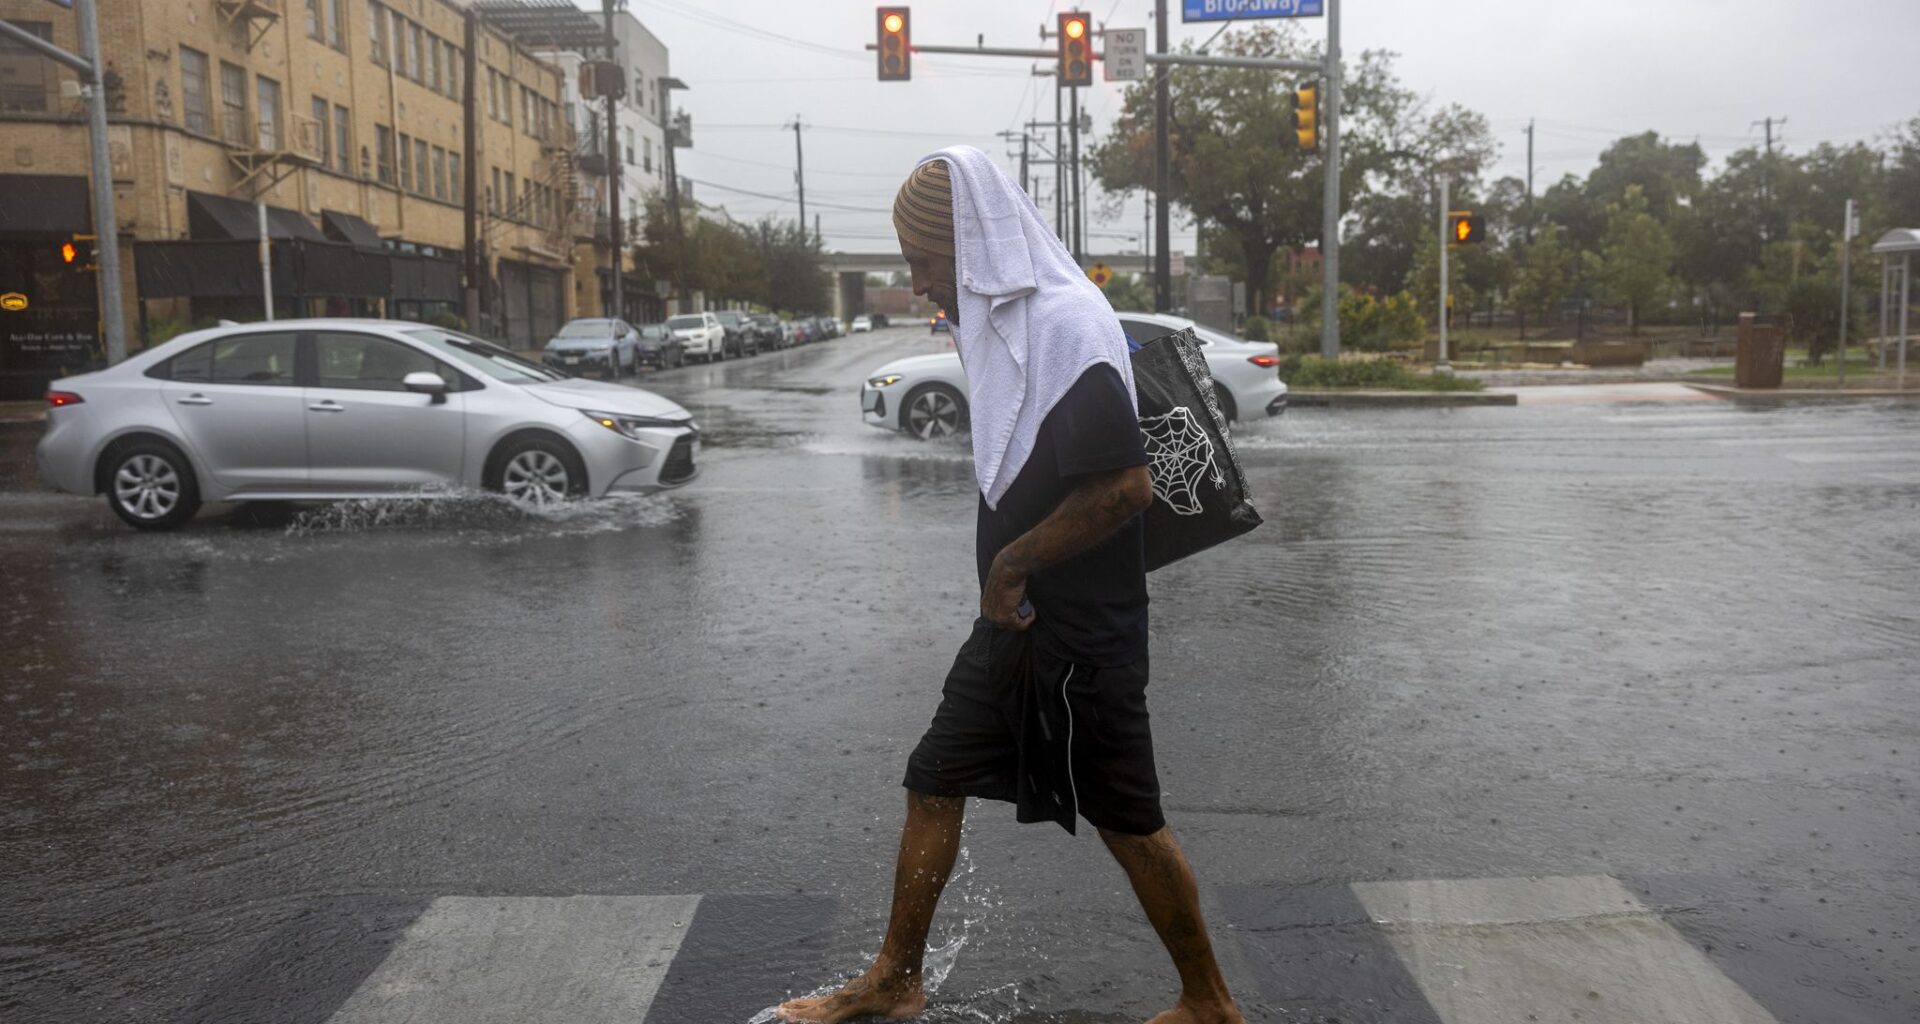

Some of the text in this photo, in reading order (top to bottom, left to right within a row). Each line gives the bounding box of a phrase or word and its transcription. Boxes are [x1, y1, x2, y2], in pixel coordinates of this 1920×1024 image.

[1116, 33, 1135, 43] NO
[1113, 46, 1138, 54] TURN
[1119, 57, 1132, 66] ON
[1116, 68, 1135, 76] RED
